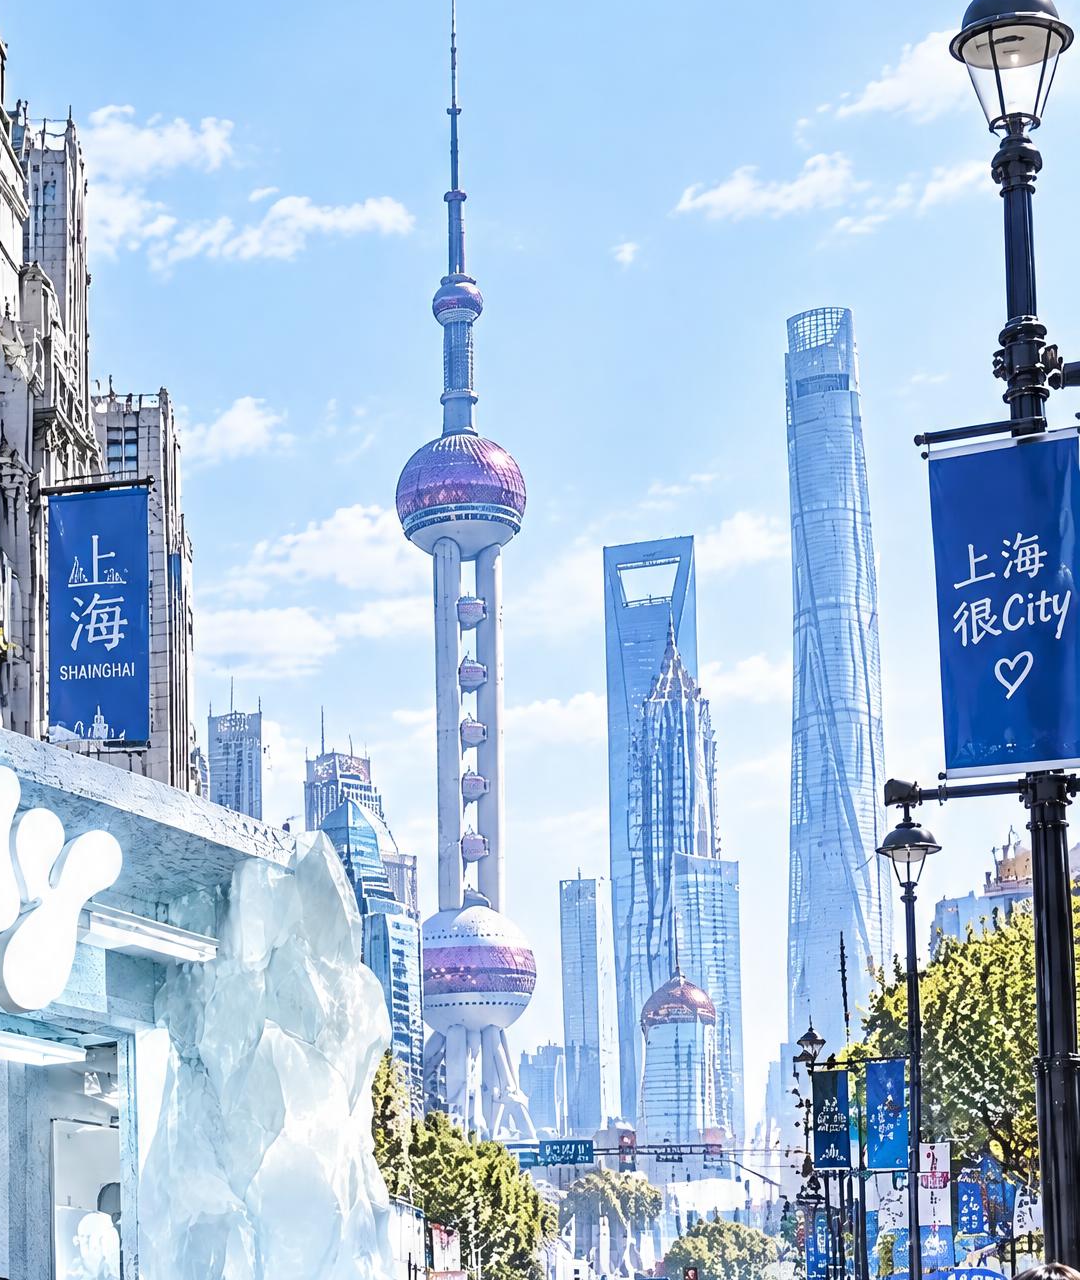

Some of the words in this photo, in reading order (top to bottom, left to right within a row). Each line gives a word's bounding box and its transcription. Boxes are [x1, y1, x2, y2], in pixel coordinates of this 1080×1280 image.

[953, 532, 1048, 590] 上海
[68, 534, 129, 652] 上海
[59, 662, 135, 681] SHAINGHAI
